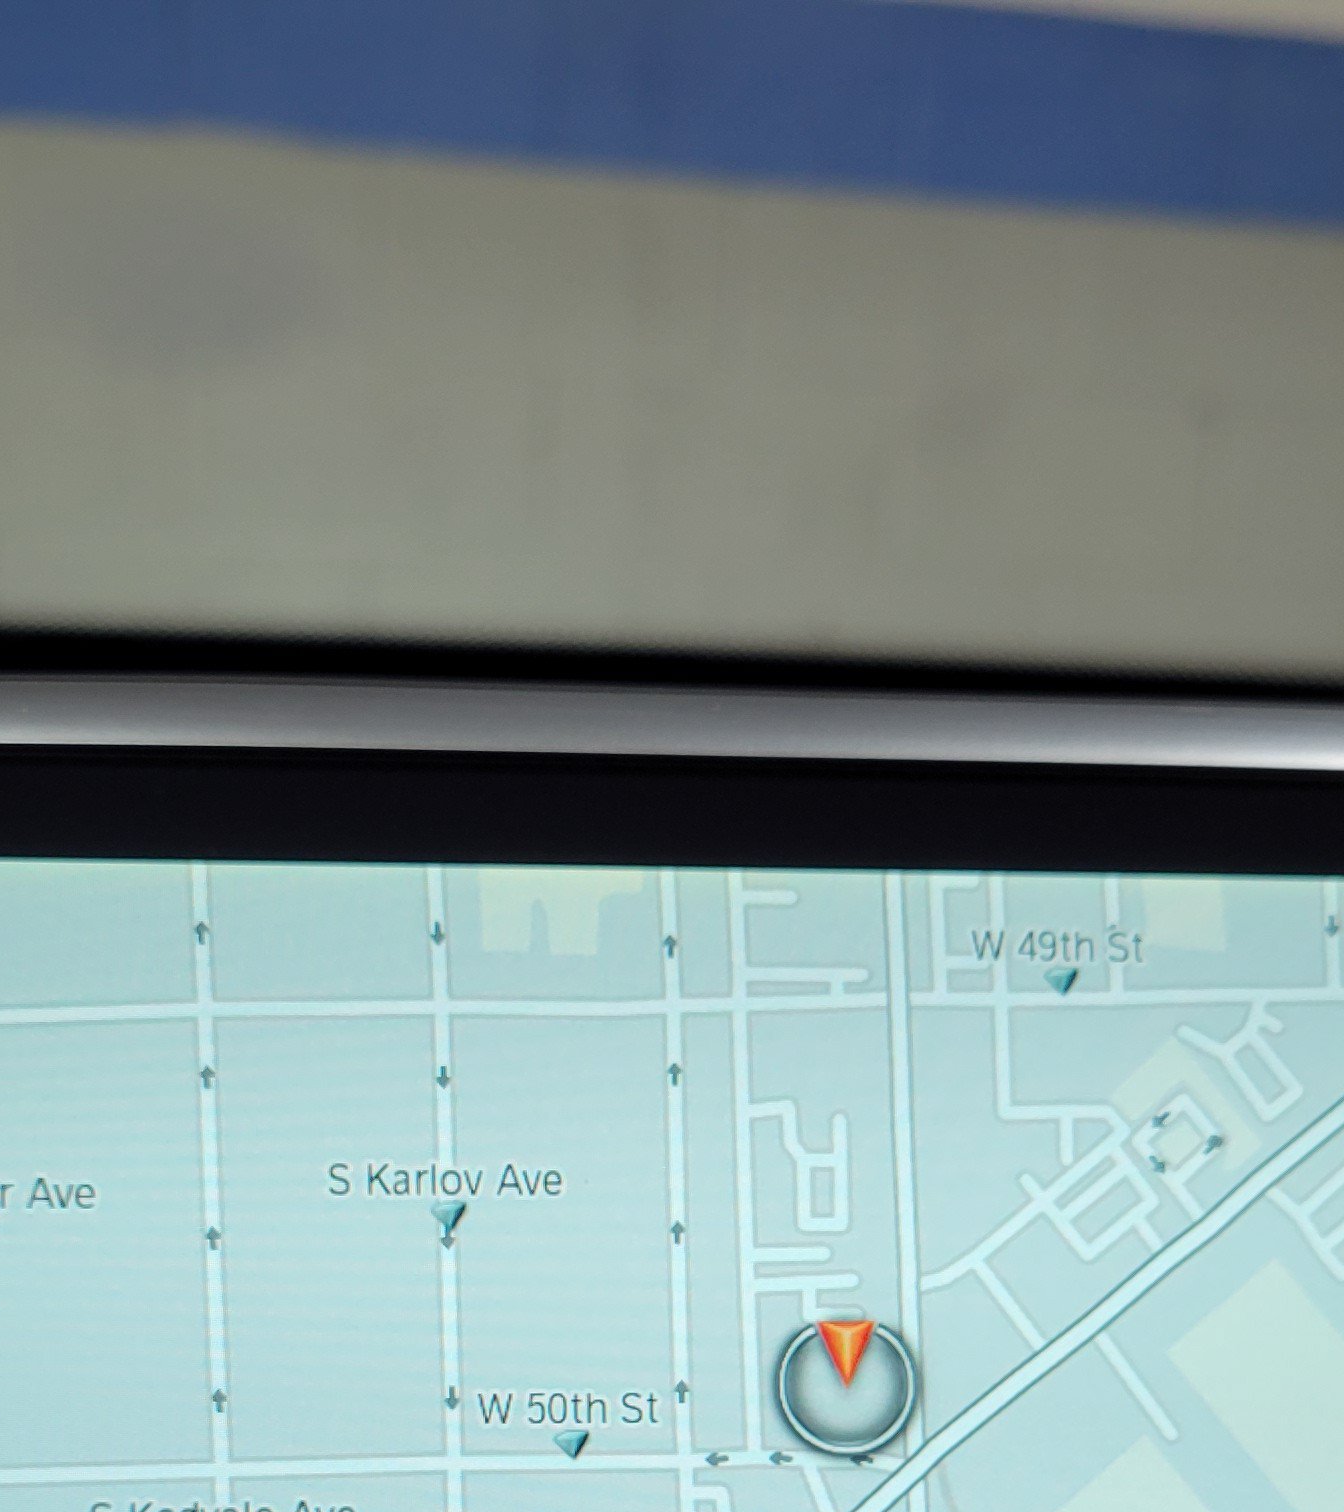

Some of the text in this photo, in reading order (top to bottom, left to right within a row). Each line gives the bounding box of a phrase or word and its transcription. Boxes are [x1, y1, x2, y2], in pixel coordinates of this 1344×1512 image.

[971, 929, 1144, 964] W 49th St
[25, 1176, 96, 1209] Ave
[328, 1162, 562, 1196] S Karlov Ave
[477, 1391, 659, 1424] W 50th St
